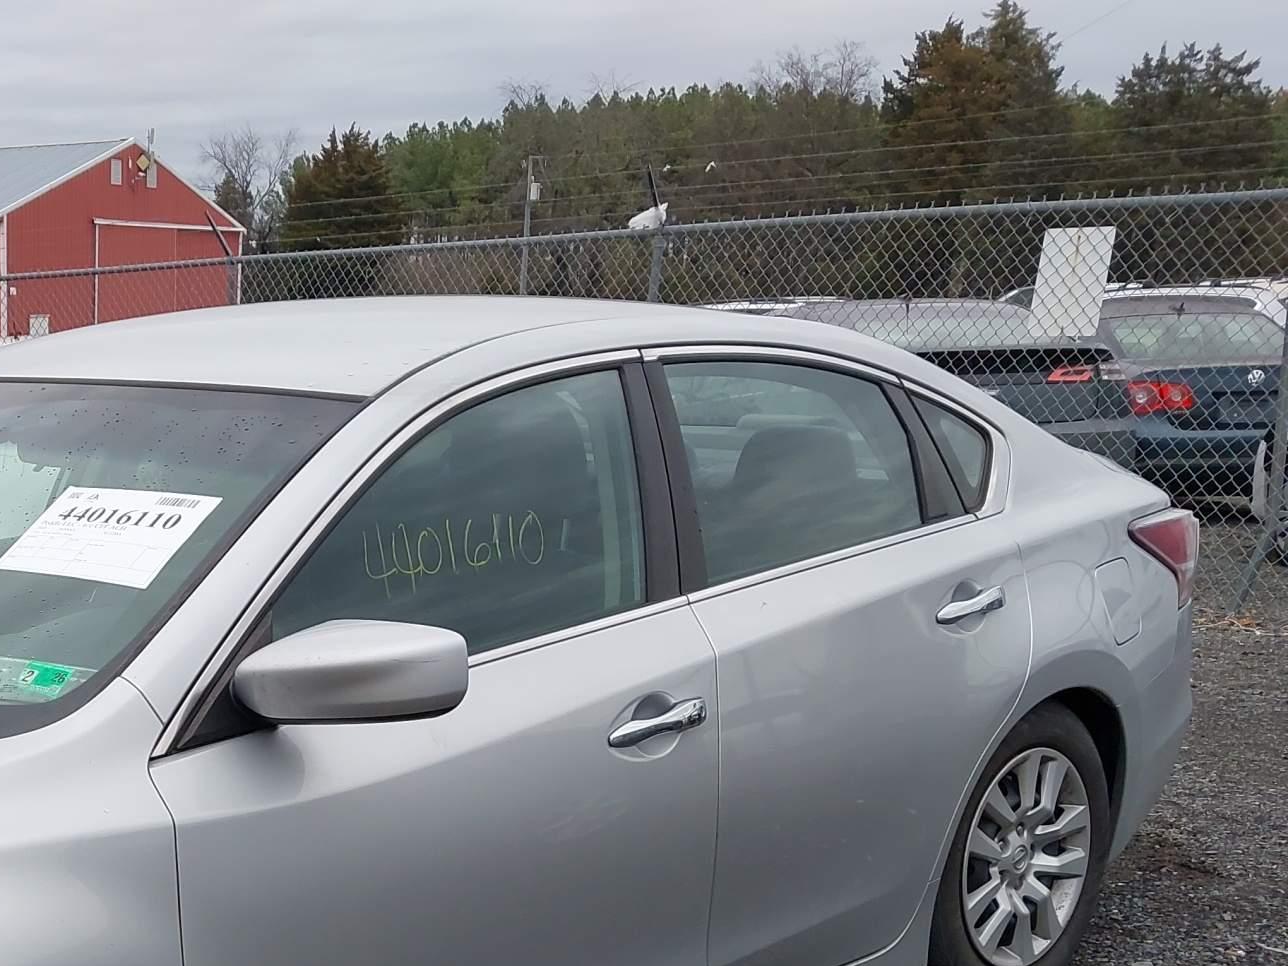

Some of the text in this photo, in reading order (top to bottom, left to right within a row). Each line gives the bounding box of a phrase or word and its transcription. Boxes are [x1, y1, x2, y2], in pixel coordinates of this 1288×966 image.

[58, 505, 182, 530] 44016110
[362, 510, 544, 599] 44016110
[21, 670, 34, 682] 2
[53, 671, 69, 685] 26
